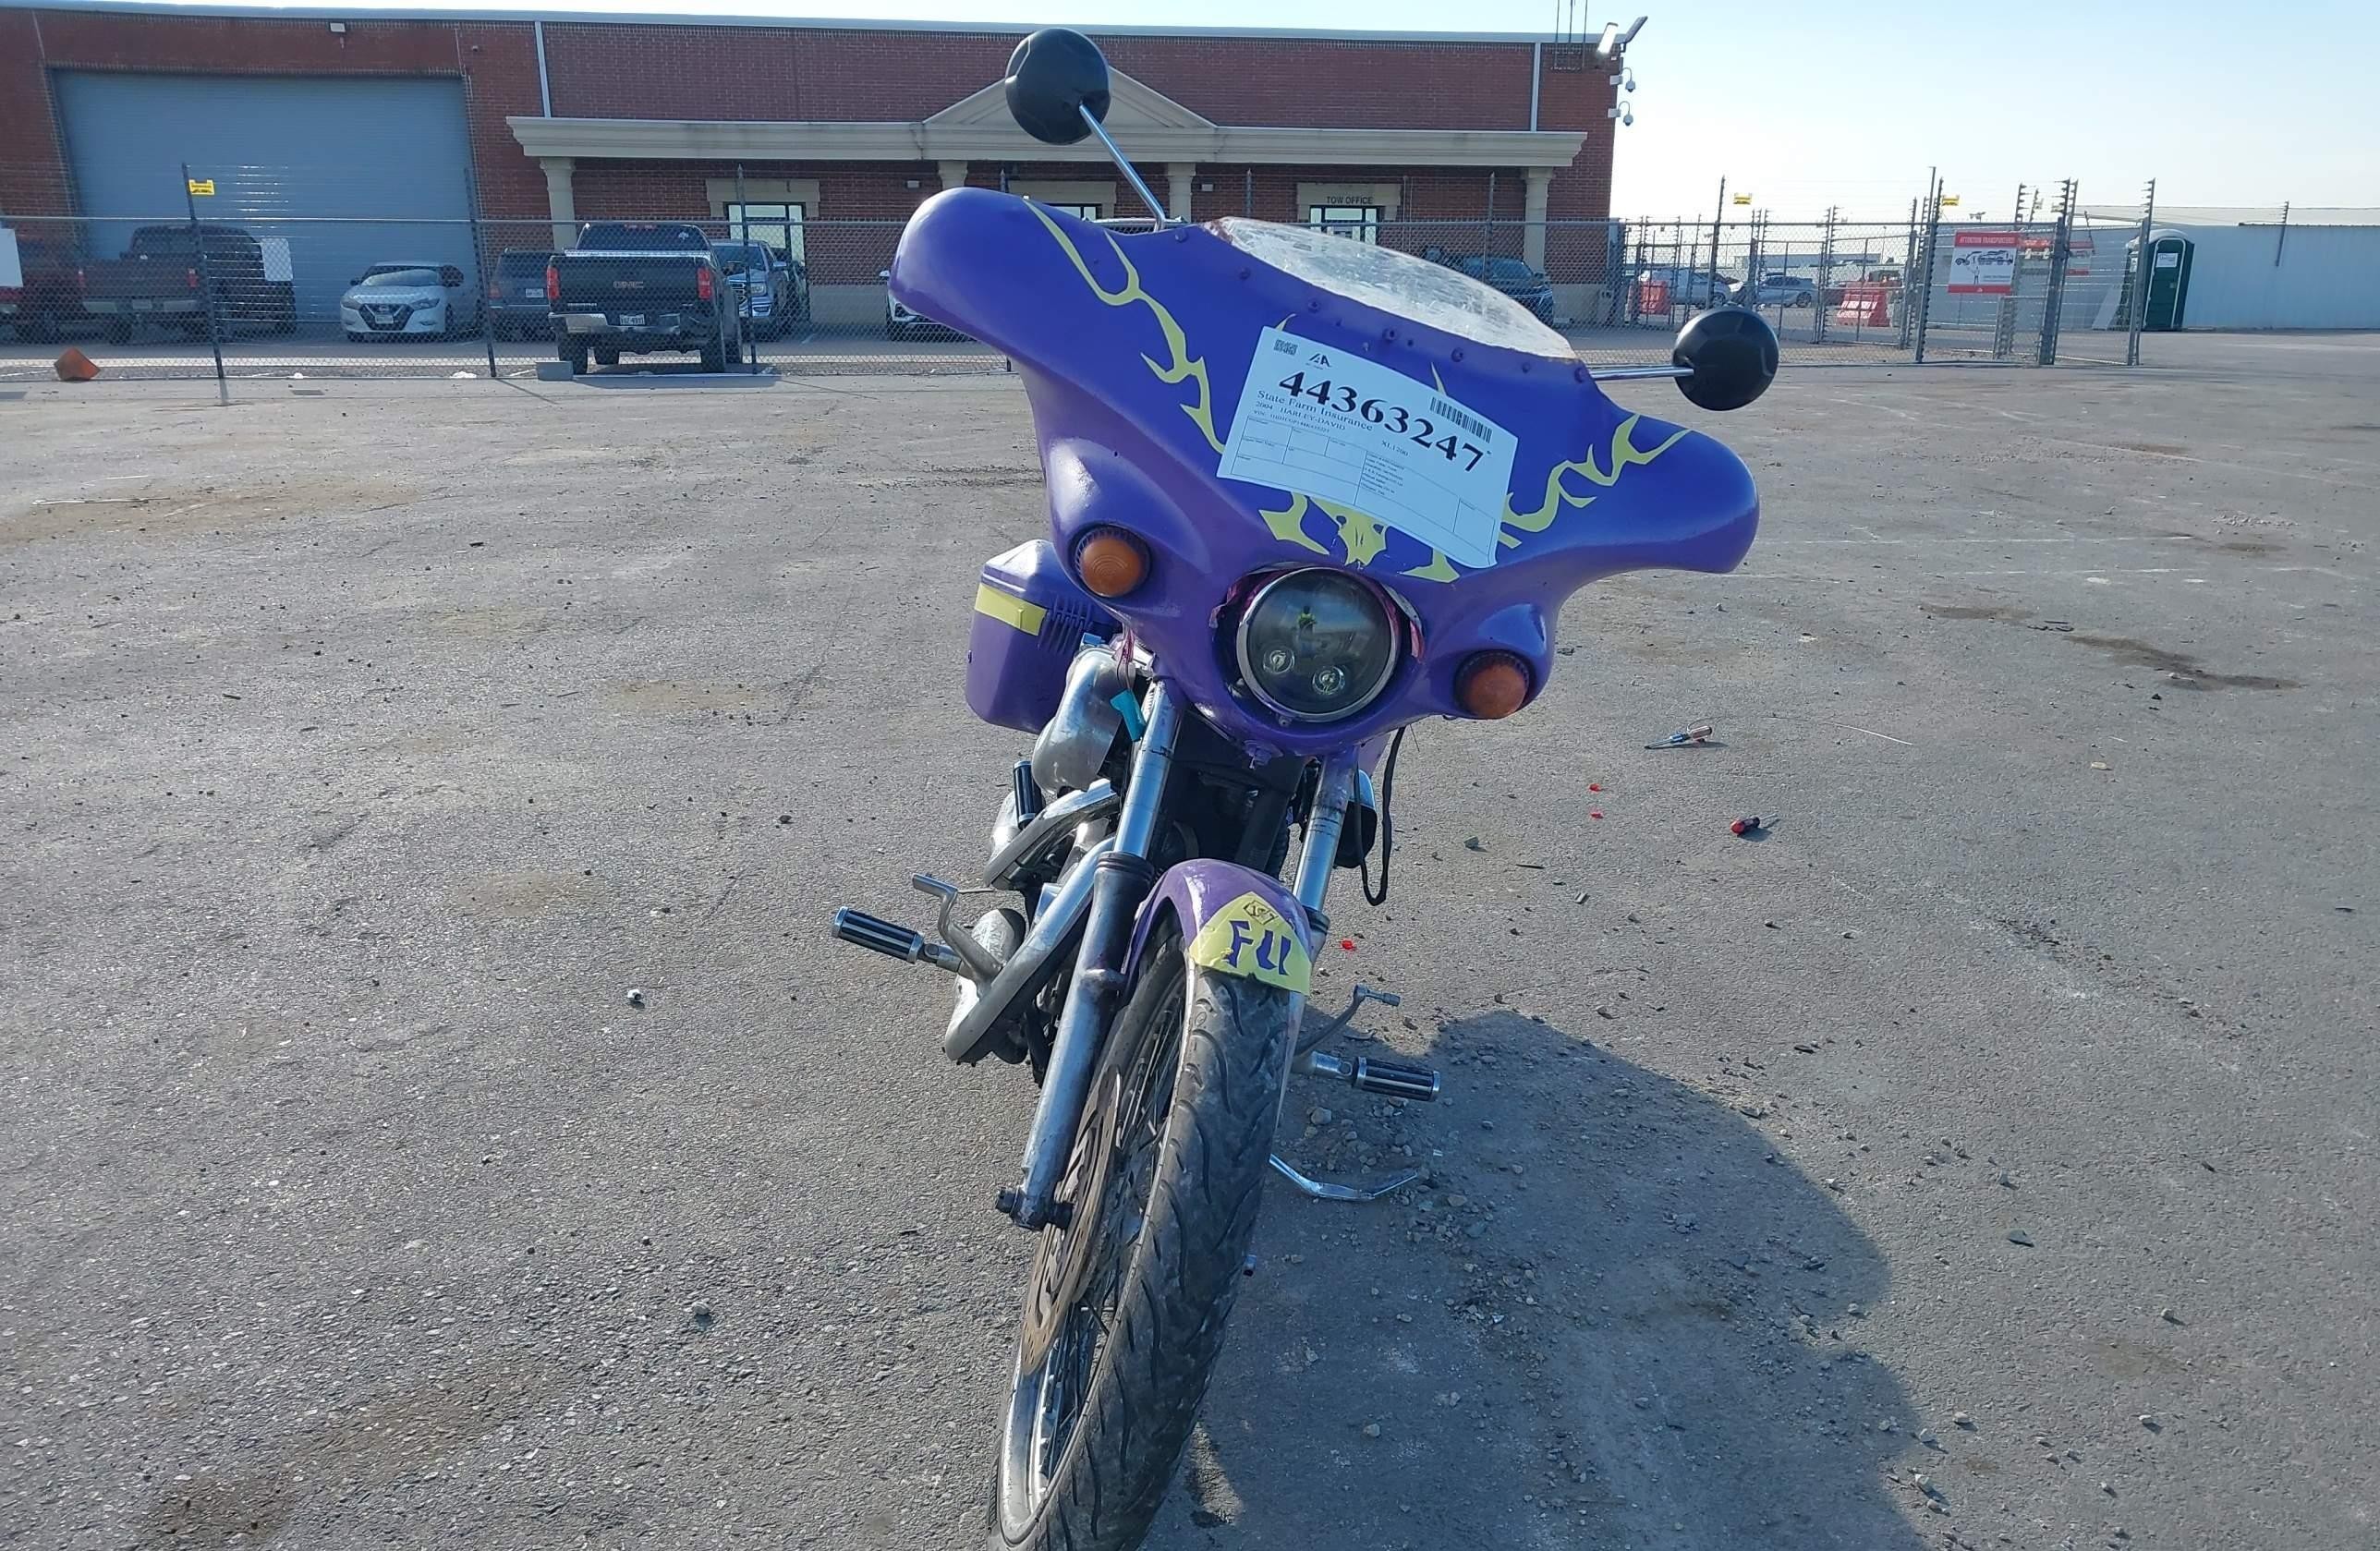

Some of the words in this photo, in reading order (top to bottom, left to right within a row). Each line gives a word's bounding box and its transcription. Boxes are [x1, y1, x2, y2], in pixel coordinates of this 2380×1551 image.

[1326, 196, 1343, 204] TOW
[1345, 196, 1374, 204] OFFICE
[1257, 390, 1285, 404] State
[1288, 399, 1318, 413] Farm
[1320, 407, 1373, 431] Insurance
